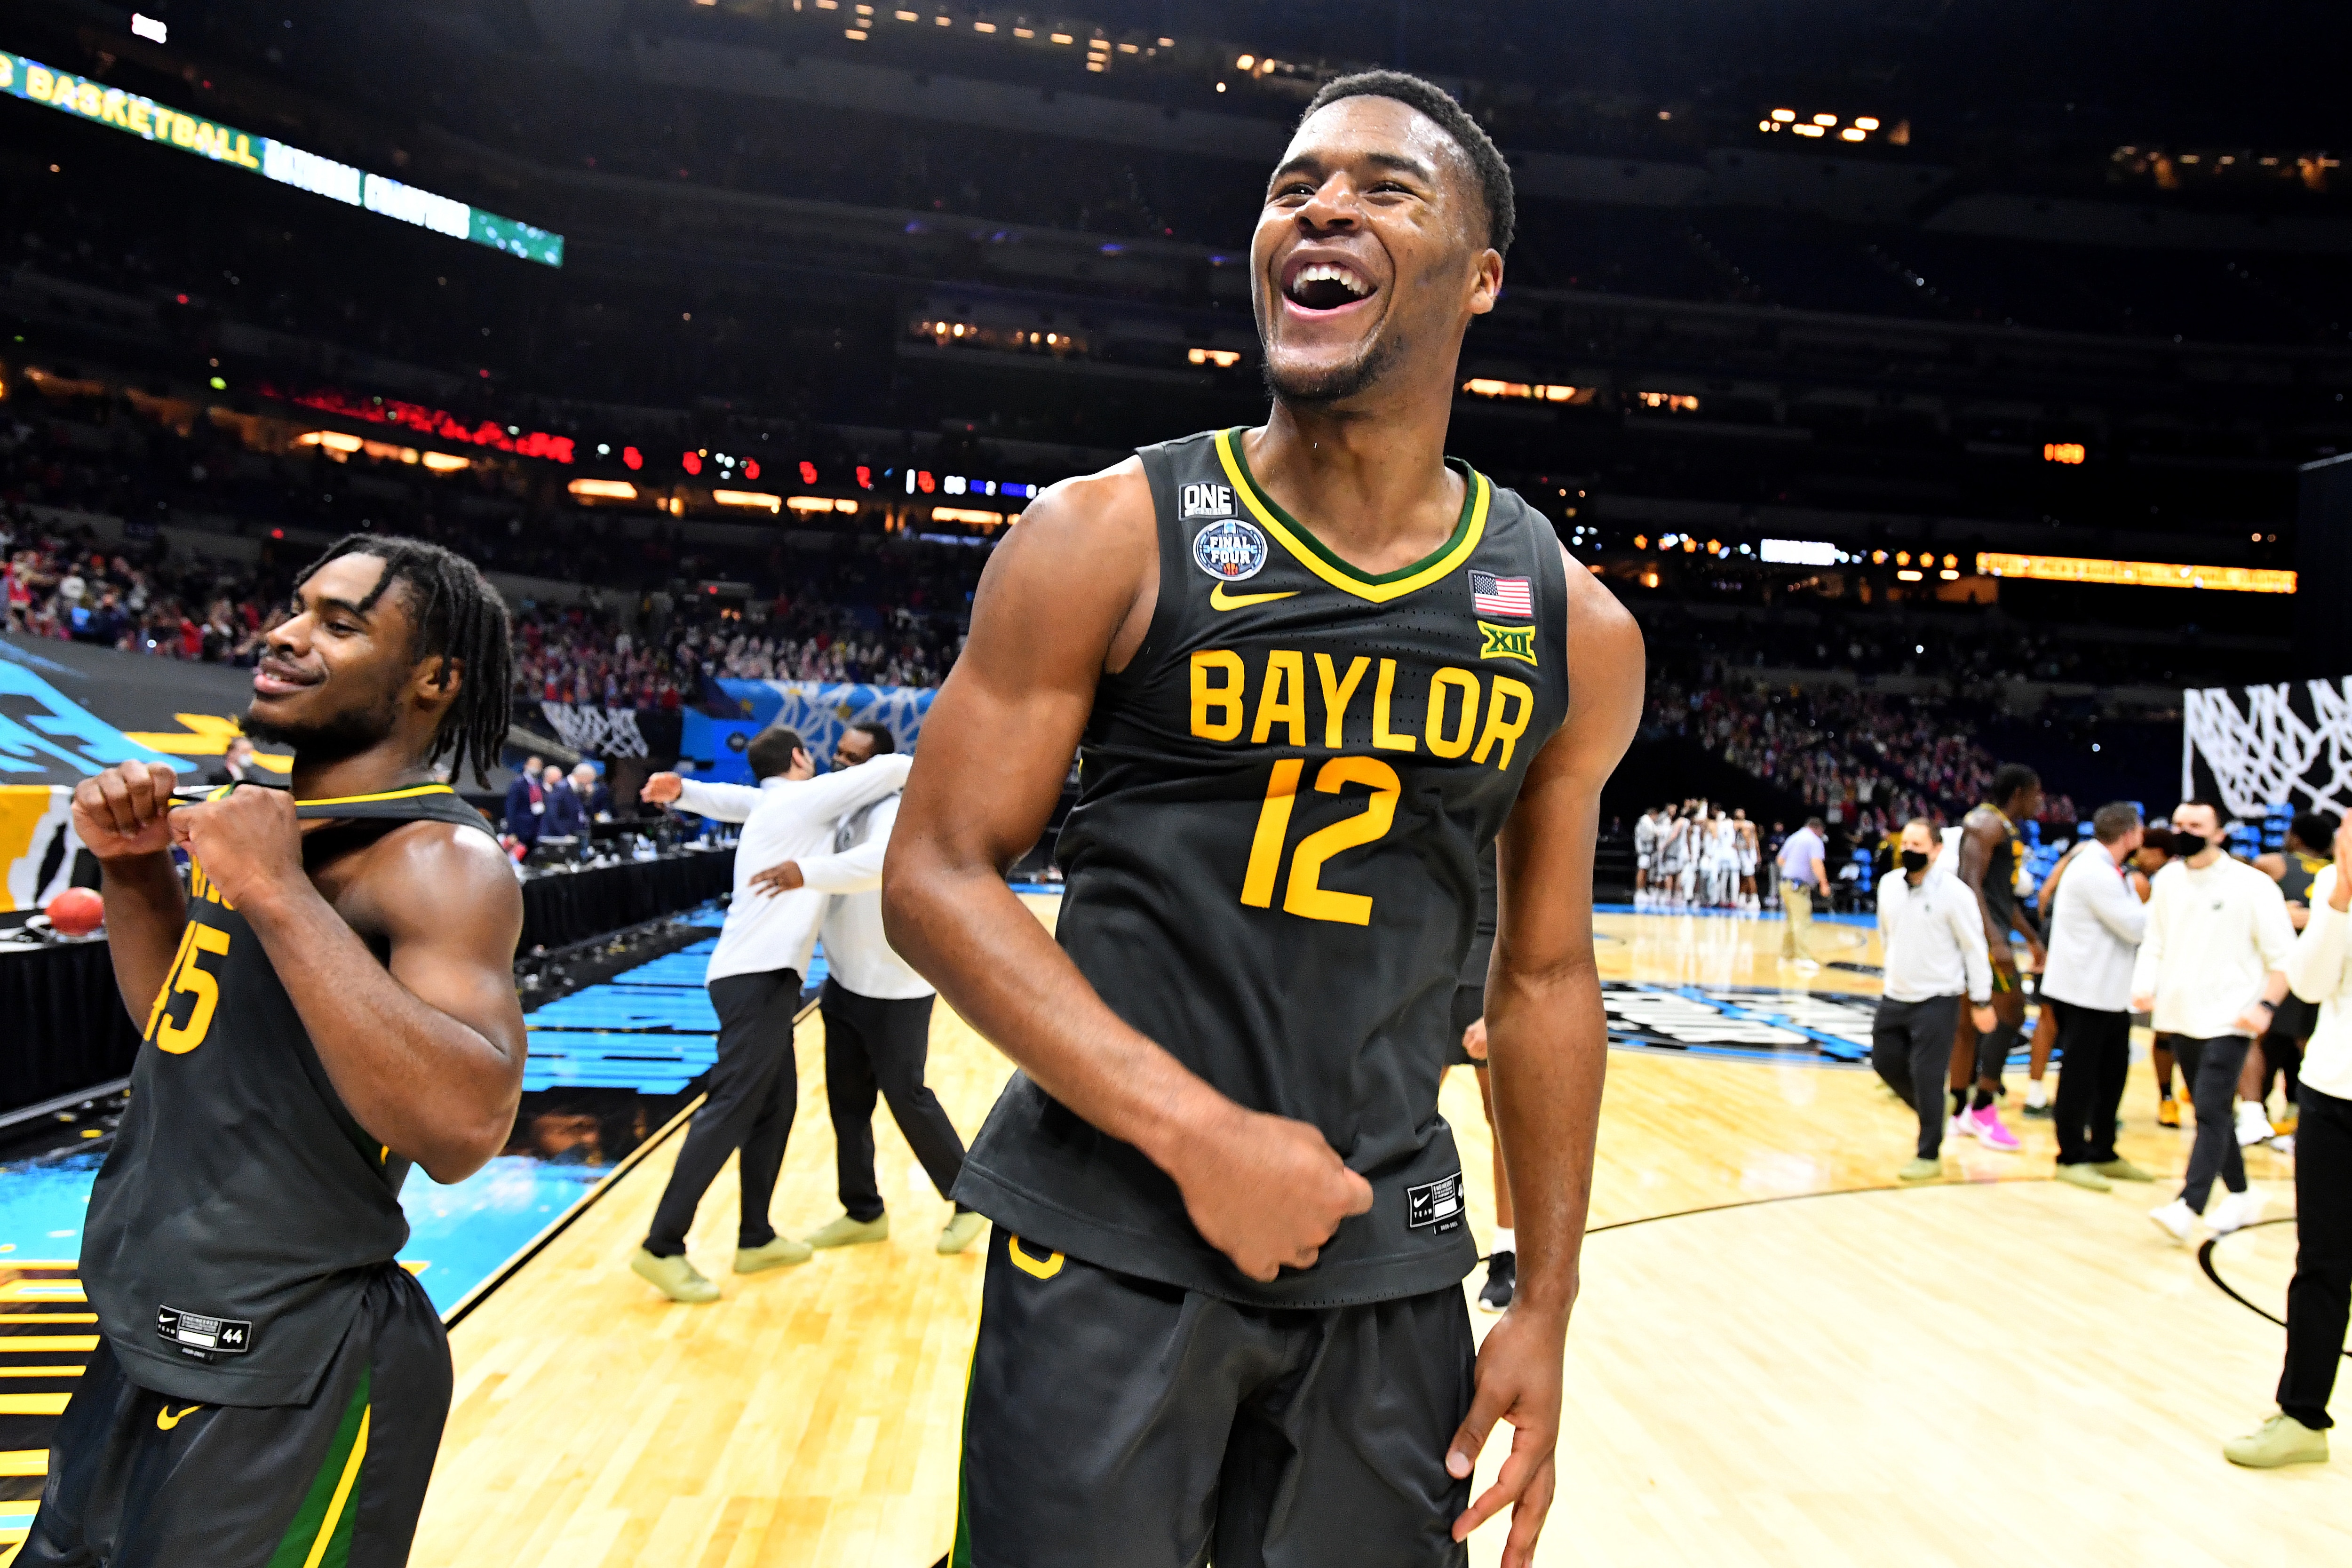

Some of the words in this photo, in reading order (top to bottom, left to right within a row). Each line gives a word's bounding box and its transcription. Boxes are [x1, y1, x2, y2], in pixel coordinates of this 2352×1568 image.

[26, 65, 259, 168] BASKETBALL
[1184, 484, 1232, 509] ONE
[1210, 536, 1250, 549] FINAL
[1211, 550, 1250, 564] FOUR
[1483, 626, 1533, 659] XII
[1191, 649, 1534, 771] BAYLOR
[1240, 755, 1401, 926] 12
[1414, 1208, 1432, 1218] TEAM
[222, 1329, 243, 1344] 44
